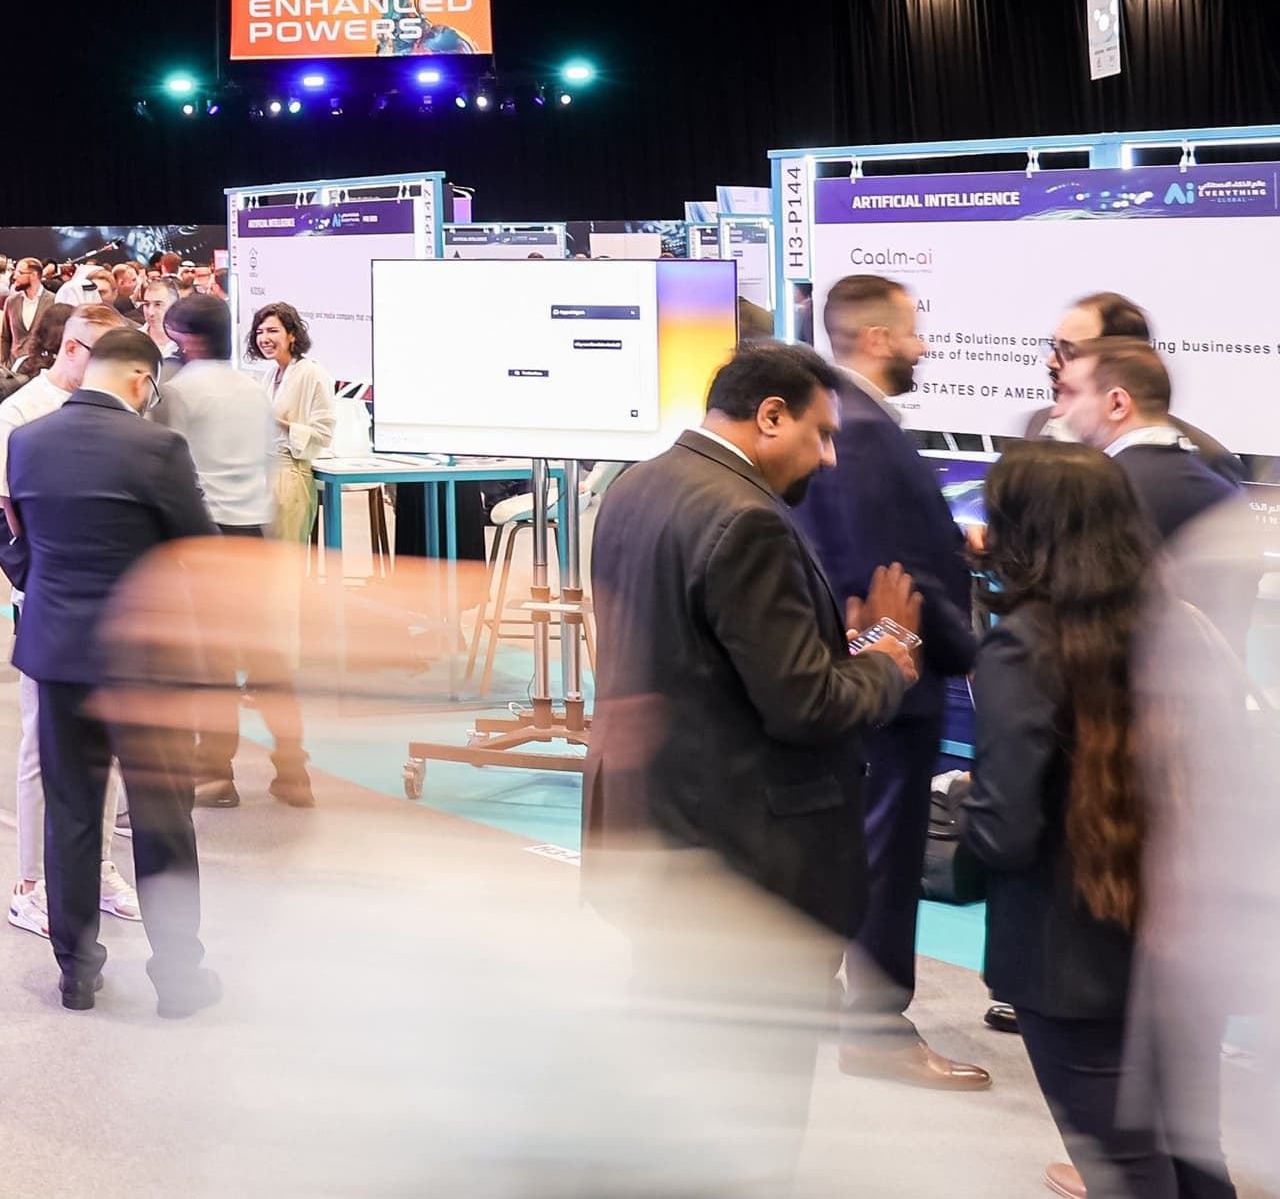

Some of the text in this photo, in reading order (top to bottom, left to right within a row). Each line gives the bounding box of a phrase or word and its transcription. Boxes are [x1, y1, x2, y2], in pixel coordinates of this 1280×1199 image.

[250, 18, 422, 43] POWERS
[852, 192, 1020, 209] ARTIFICIAL INTELLIGENCE
[1198, 189, 1267, 197] EVERYTHING
[787, 167, 803, 267] H3-P144
[850, 248, 932, 264] Caalm-ai
[929, 333, 951, 344] and
[955, 333, 1016, 346] Solutions
[1153, 339, 1176, 353] ing
[1182, 340, 1271, 355] businesses
[949, 349, 962, 360] of
[966, 350, 1042, 366] technology.
[923, 383, 975, 397] STATES
[980, 385, 998, 398] OF
[1004, 387, 1053, 401] AMERI
